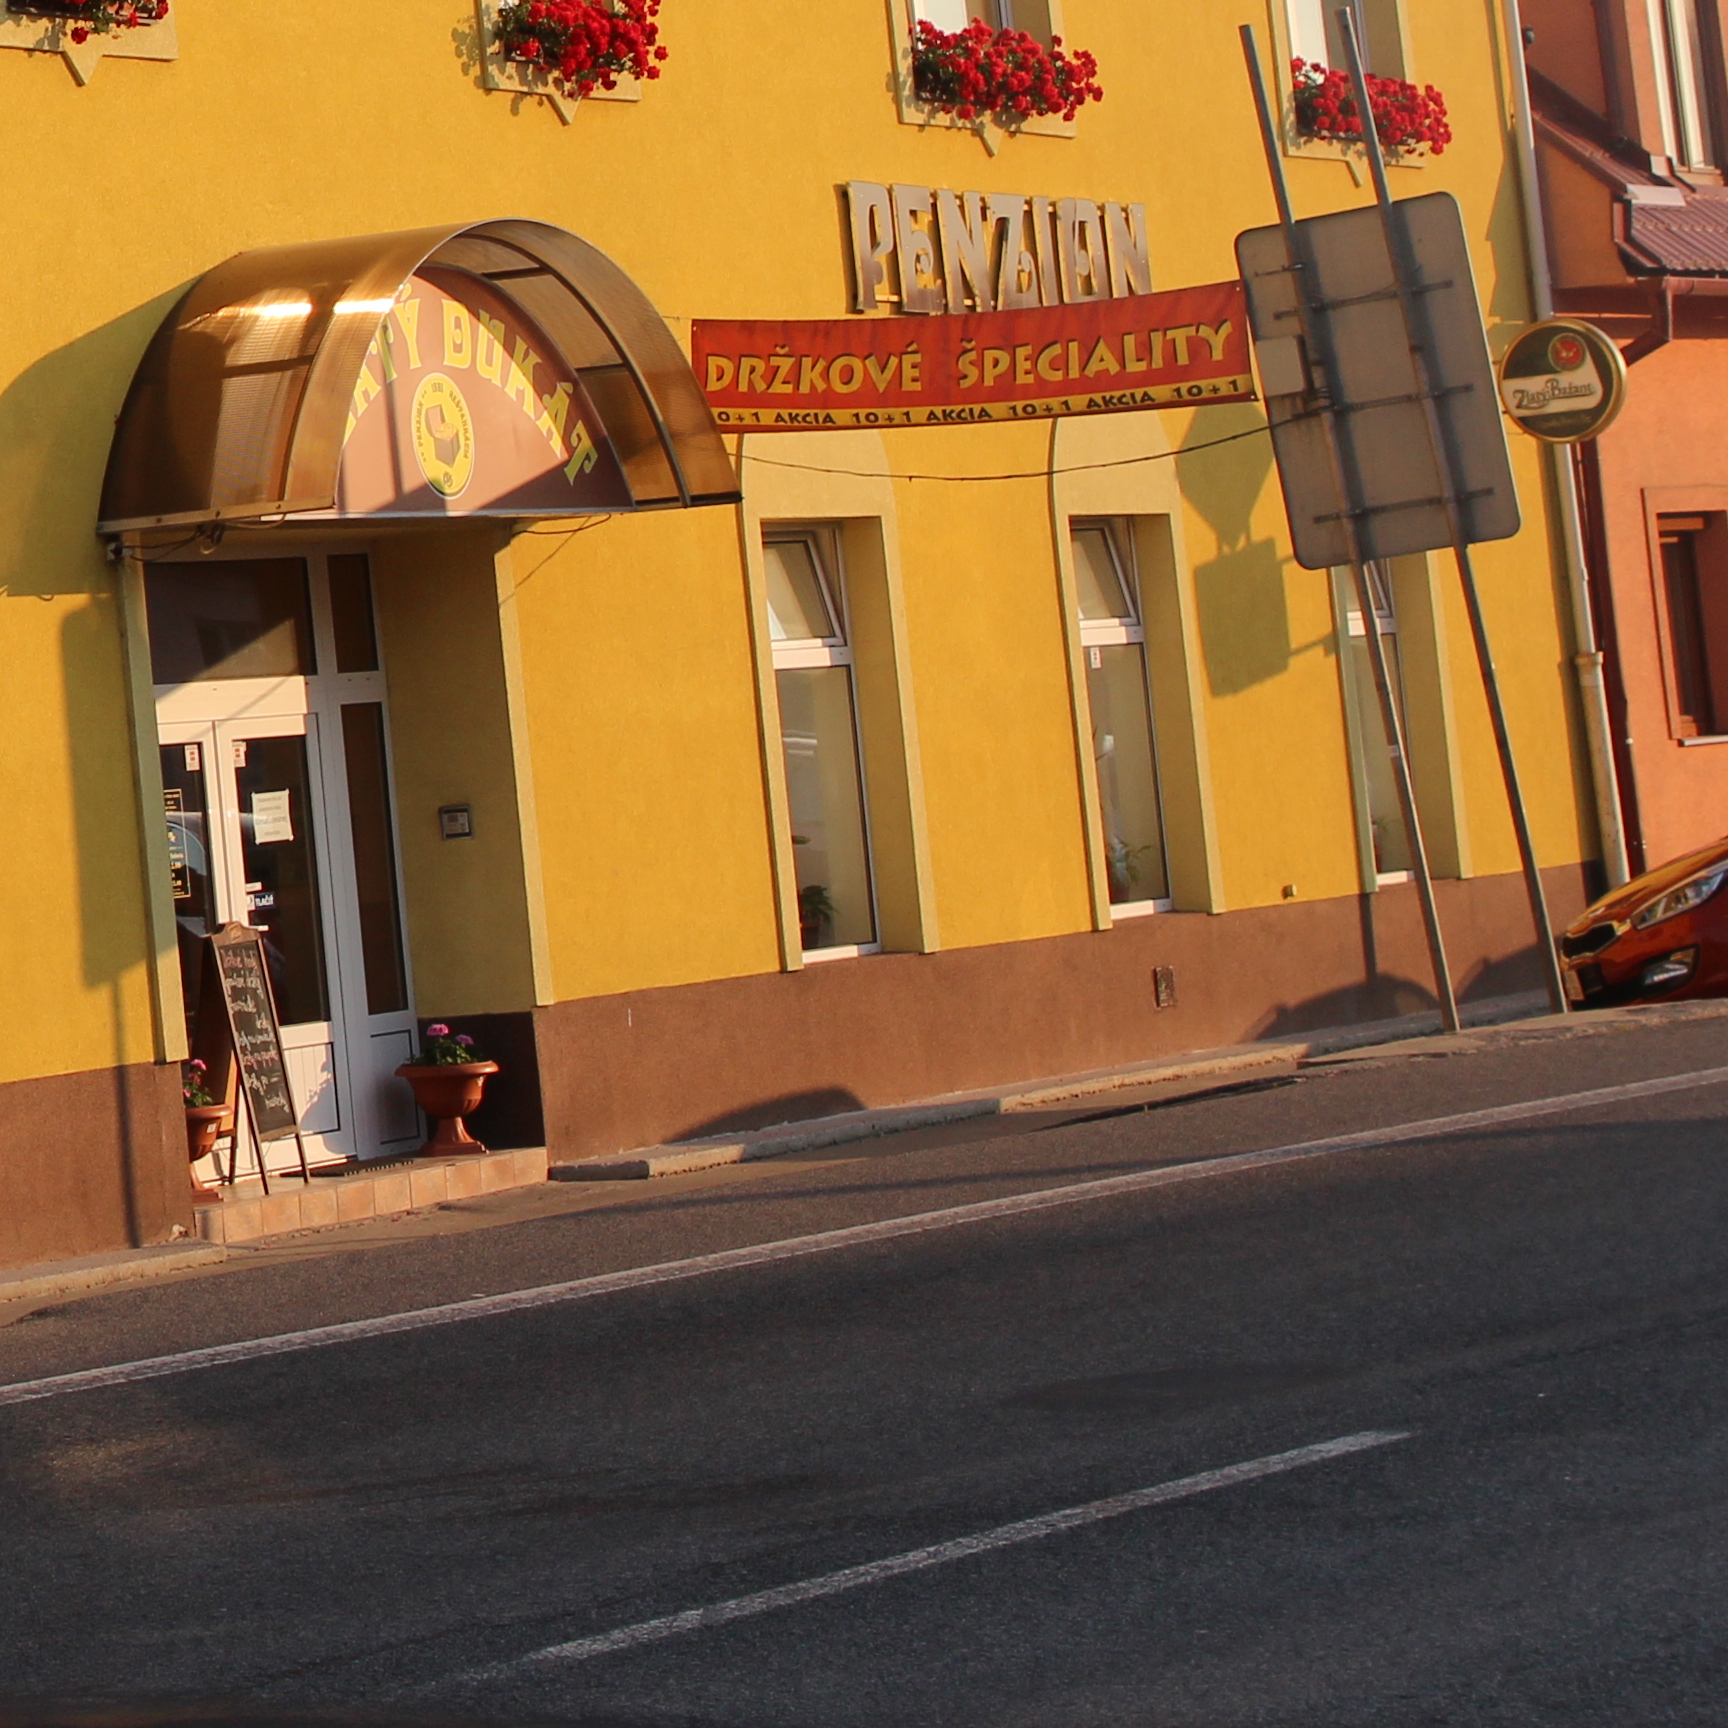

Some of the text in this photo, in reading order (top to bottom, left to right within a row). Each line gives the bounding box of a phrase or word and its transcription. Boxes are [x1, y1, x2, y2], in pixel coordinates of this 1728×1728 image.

[441, 298, 599, 487] DUKÁT
[705, 319, 1234, 394] DRŽKOVÉ ŠPECIALITY
[773, 411, 837, 425] AKCIA
[925, 406, 993, 423] AKCIA
[1085, 387, 1156, 410] AKCIA
